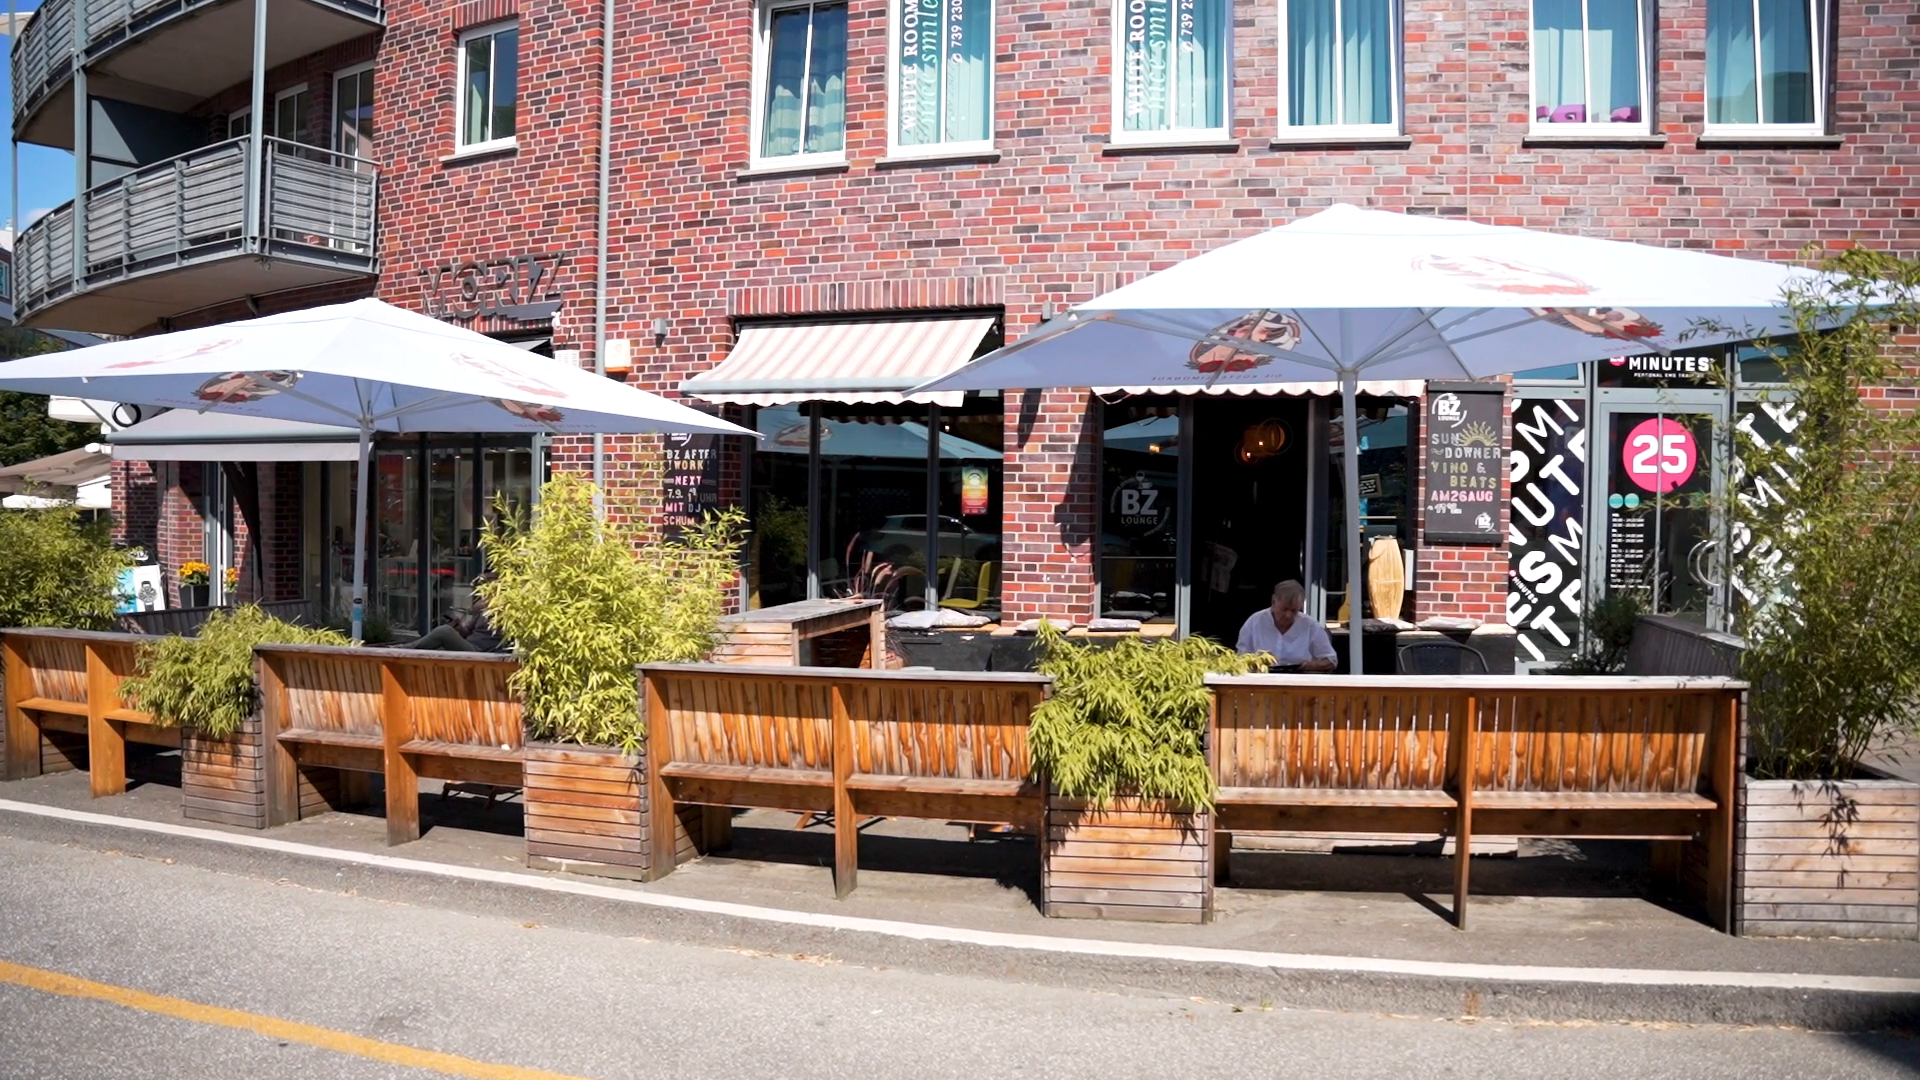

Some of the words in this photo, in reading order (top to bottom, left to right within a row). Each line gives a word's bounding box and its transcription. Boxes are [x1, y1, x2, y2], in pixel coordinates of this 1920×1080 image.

[1181, 13, 1194, 36] 739
[951, 25, 963, 47] 739
[1128, 49, 1144, 116] WHITE
[902, 63, 917, 131] WHITE
[1629, 357, 1710, 372] MINUTES
[1438, 400, 1461, 416] BZ
[1432, 433, 1460, 445] SUN
[667, 450, 680, 459] BZ
[684, 449, 717, 459] AFTER
[1445, 447, 1501, 459] DOWNER
[1632, 434, 1688, 474] 25
[1431, 461, 1468, 473] VINO
[1476, 463, 1486, 474] &
[675, 476, 702, 485] NEXT
[1450, 476, 1497, 489] BEATS
[665, 502, 684, 512] MIT
[688, 503, 701, 512] DJ
[1121, 489, 1158, 515] BZ
[1121, 517, 1158, 525] LOUNGE
